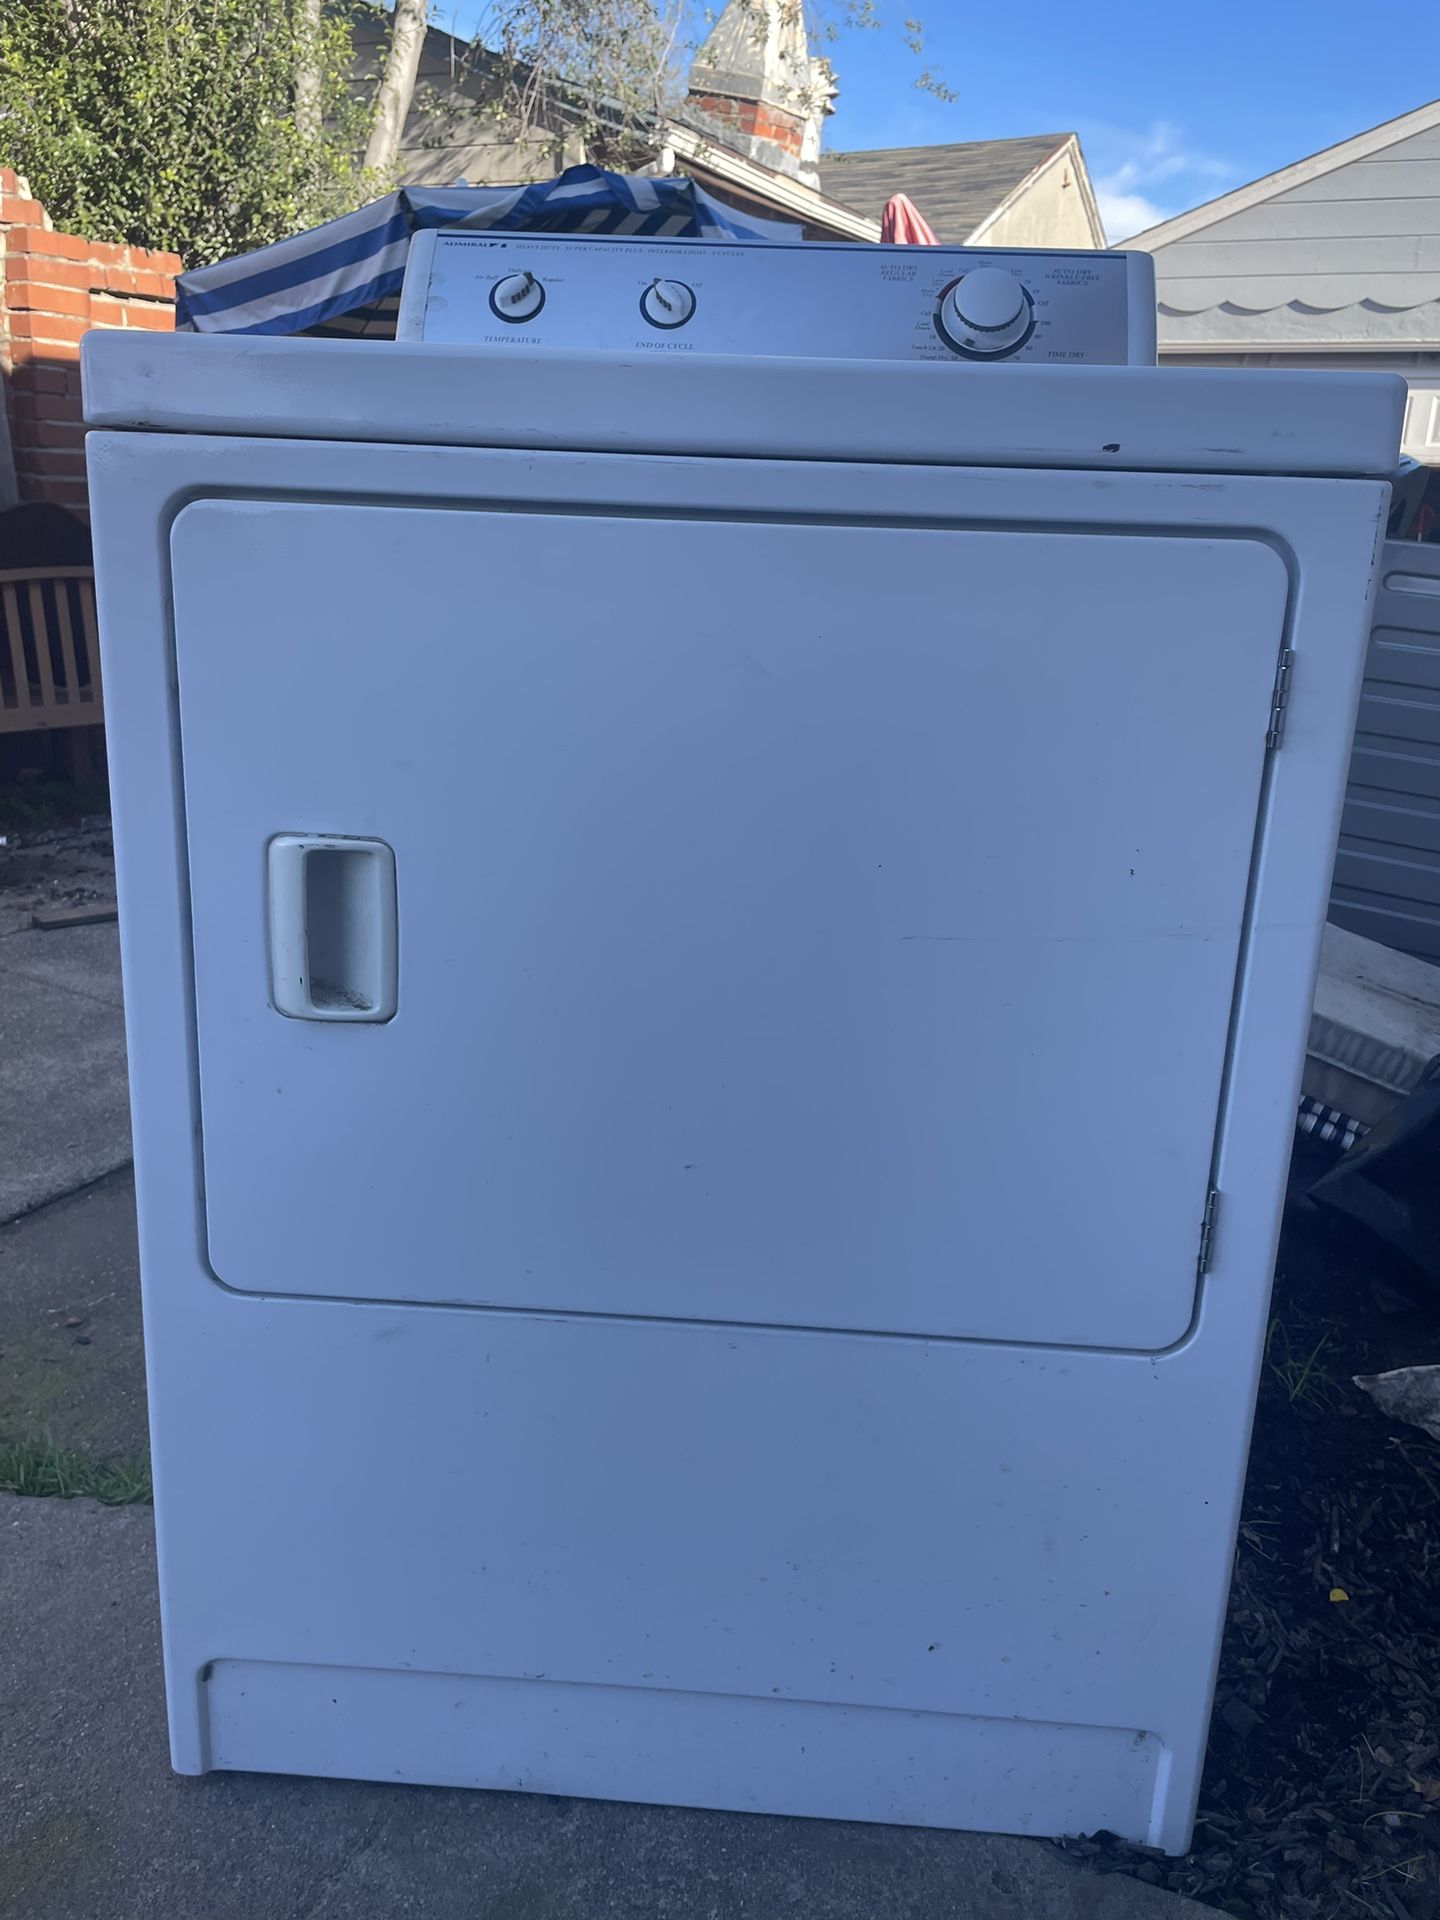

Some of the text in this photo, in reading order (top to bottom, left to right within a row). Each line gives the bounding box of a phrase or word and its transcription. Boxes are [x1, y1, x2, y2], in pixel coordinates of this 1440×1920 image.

[442, 241, 488, 249] ADMIRAL
[646, 248, 683, 256] INTERIOR
[1045, 273, 1100, 281] WRINKLE-FREE
[484, 336, 543, 345] TEMPERATURE
[635, 341, 695, 351] END OF CYCLE
